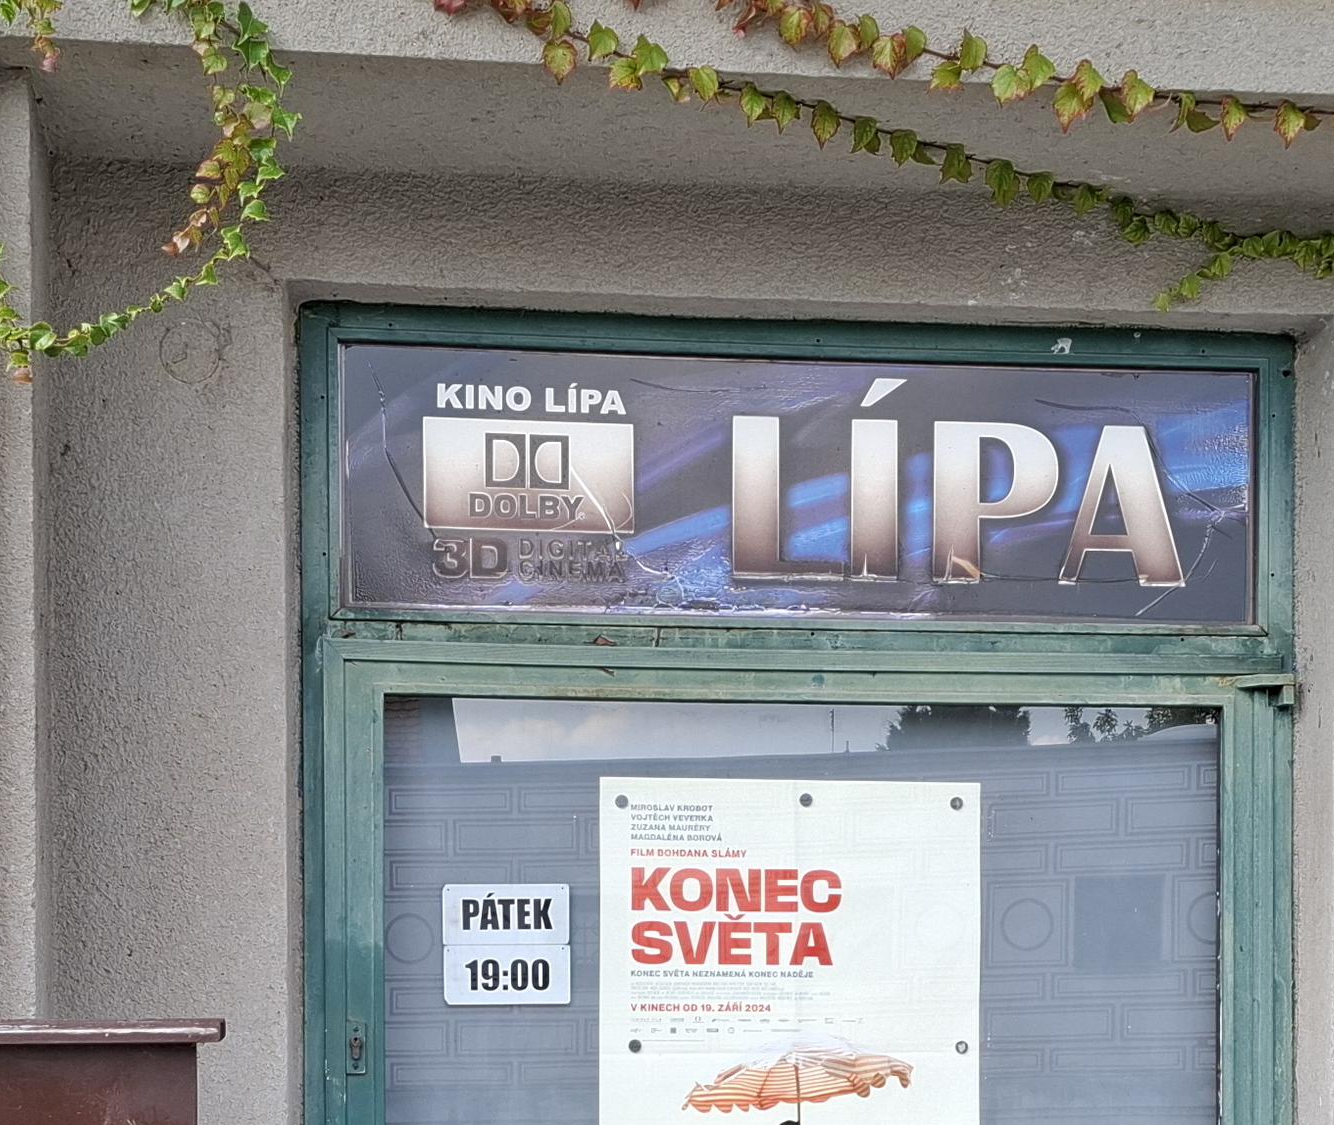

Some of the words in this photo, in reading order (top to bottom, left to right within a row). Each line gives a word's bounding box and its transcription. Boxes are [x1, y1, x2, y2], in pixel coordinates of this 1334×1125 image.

[436, 383, 532, 412] KINO
[545, 383, 627, 415] LÍPA
[732, 377, 1186, 587] LÍPA
[468, 492, 585, 520] DOLBY
[433, 538, 508, 579] 3D
[519, 538, 629, 562] DIGITAL
[519, 560, 628, 583] CINEMA
[673, 814, 714, 822] VEVERKA
[677, 804, 714, 812] KROBOT
[630, 833, 685, 841] MAGDALÉNA
[687, 833, 723, 842] BOROVÁ
[630, 848, 655, 857] FILM
[657, 848, 709, 858] BOHDANA
[711, 847, 747, 858] SLÁMY
[630, 867, 843, 913] KONEC
[462, 892, 553, 931] PÁTEK
[630, 913, 834, 966] SVĚTA
[465, 958, 551, 992] 19:00
[630, 970, 661, 978] KONEC
[663, 969, 690, 978] SVĚTA
[692, 969, 747, 978] NEZNAMENÁ
[749, 970, 778, 978] KONEC
[780, 969, 814, 979] NADĚJE
[630, 1003, 638, 1012] V
[640, 1003, 681, 1012] KINECH
[682, 1003, 698, 1012] OD
[701, 1003, 716, 1012] 19.
[717, 1001, 743, 1012] ZÁŘÍ
[745, 1004, 772, 1012] 2024
